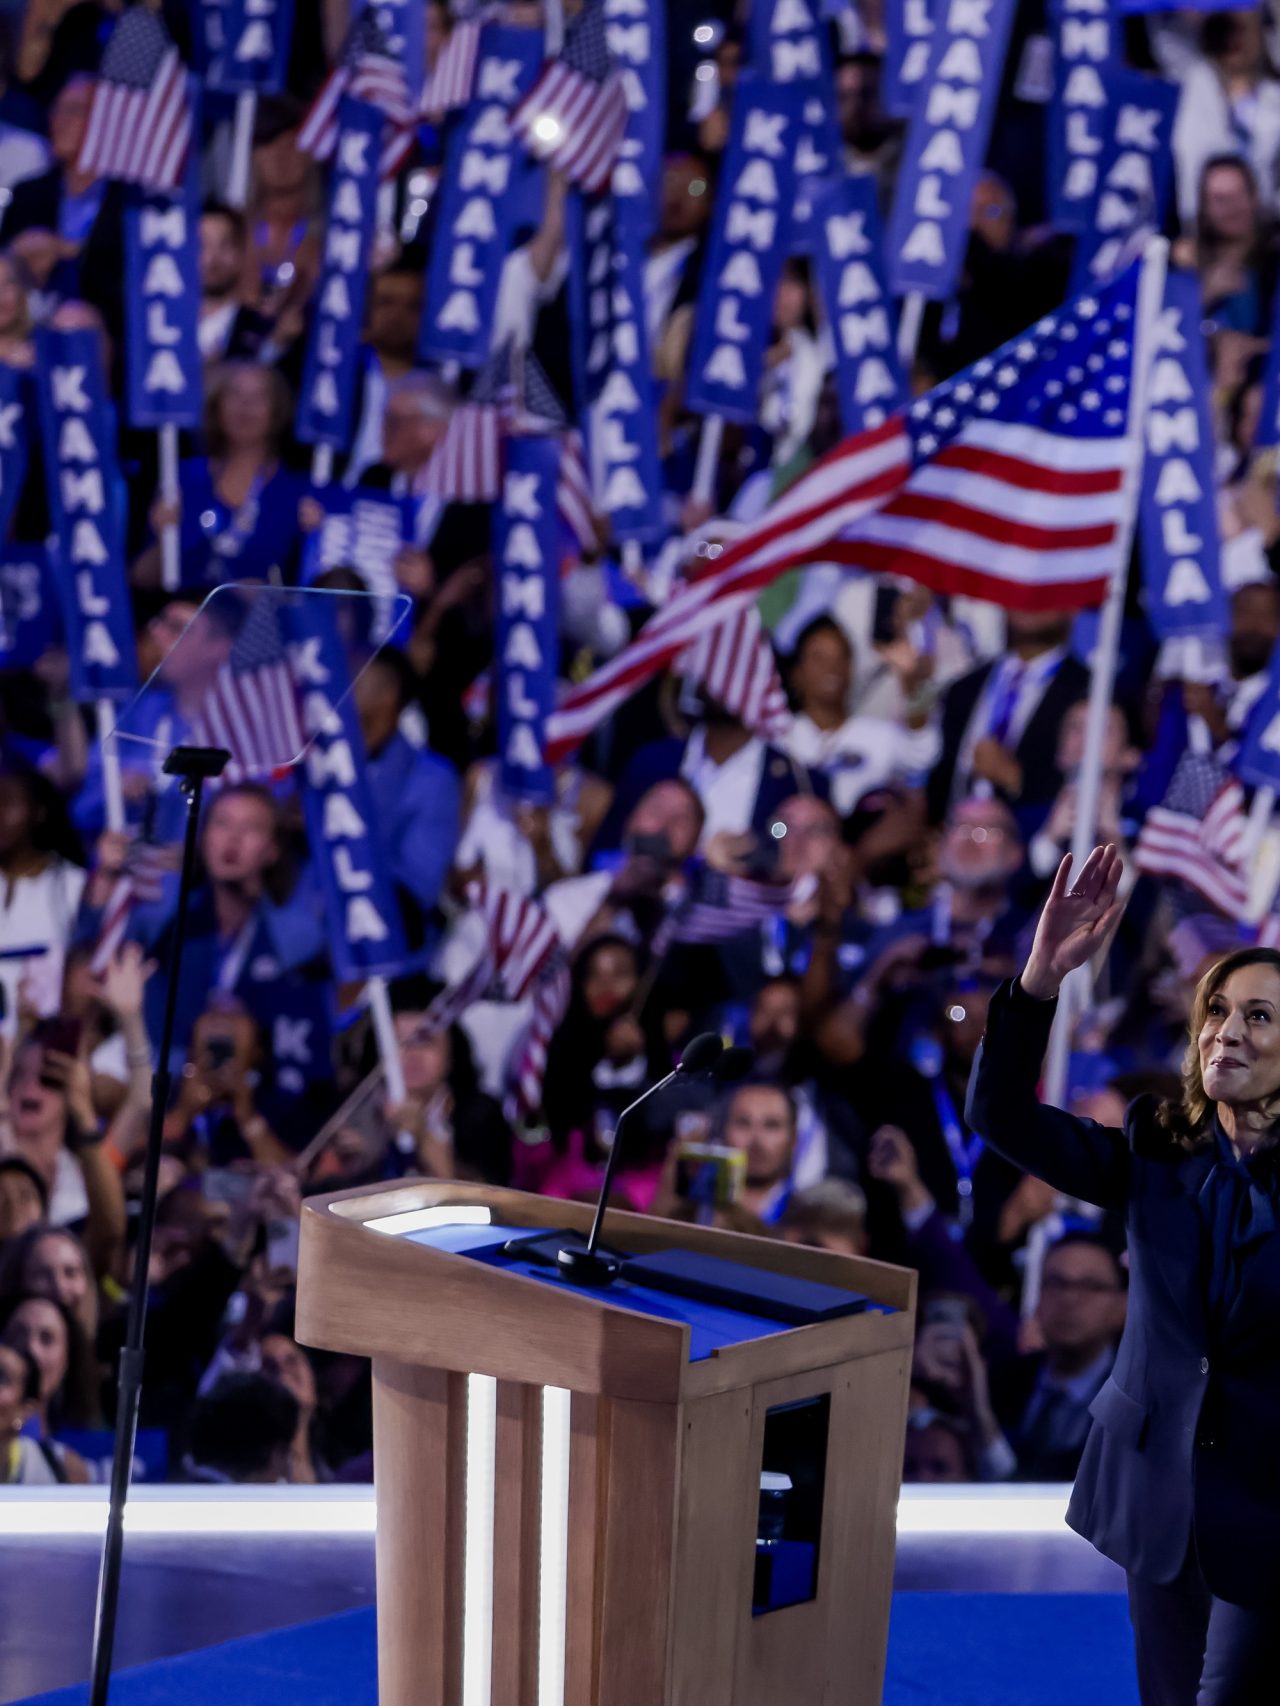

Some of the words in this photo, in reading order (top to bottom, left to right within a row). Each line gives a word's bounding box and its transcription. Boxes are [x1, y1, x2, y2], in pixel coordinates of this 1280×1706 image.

[435, 56, 524, 334] KAMALA
[1060, 0, 1111, 199] MALA
[312, 129, 372, 416] KAMALA
[703, 107, 788, 390] KAMALA
[49, 364, 120, 669] KAMALA
[1144, 306, 1212, 608] KAMALA
[502, 472, 546, 770] KAMALA
[288, 636, 389, 944] KAMALA
